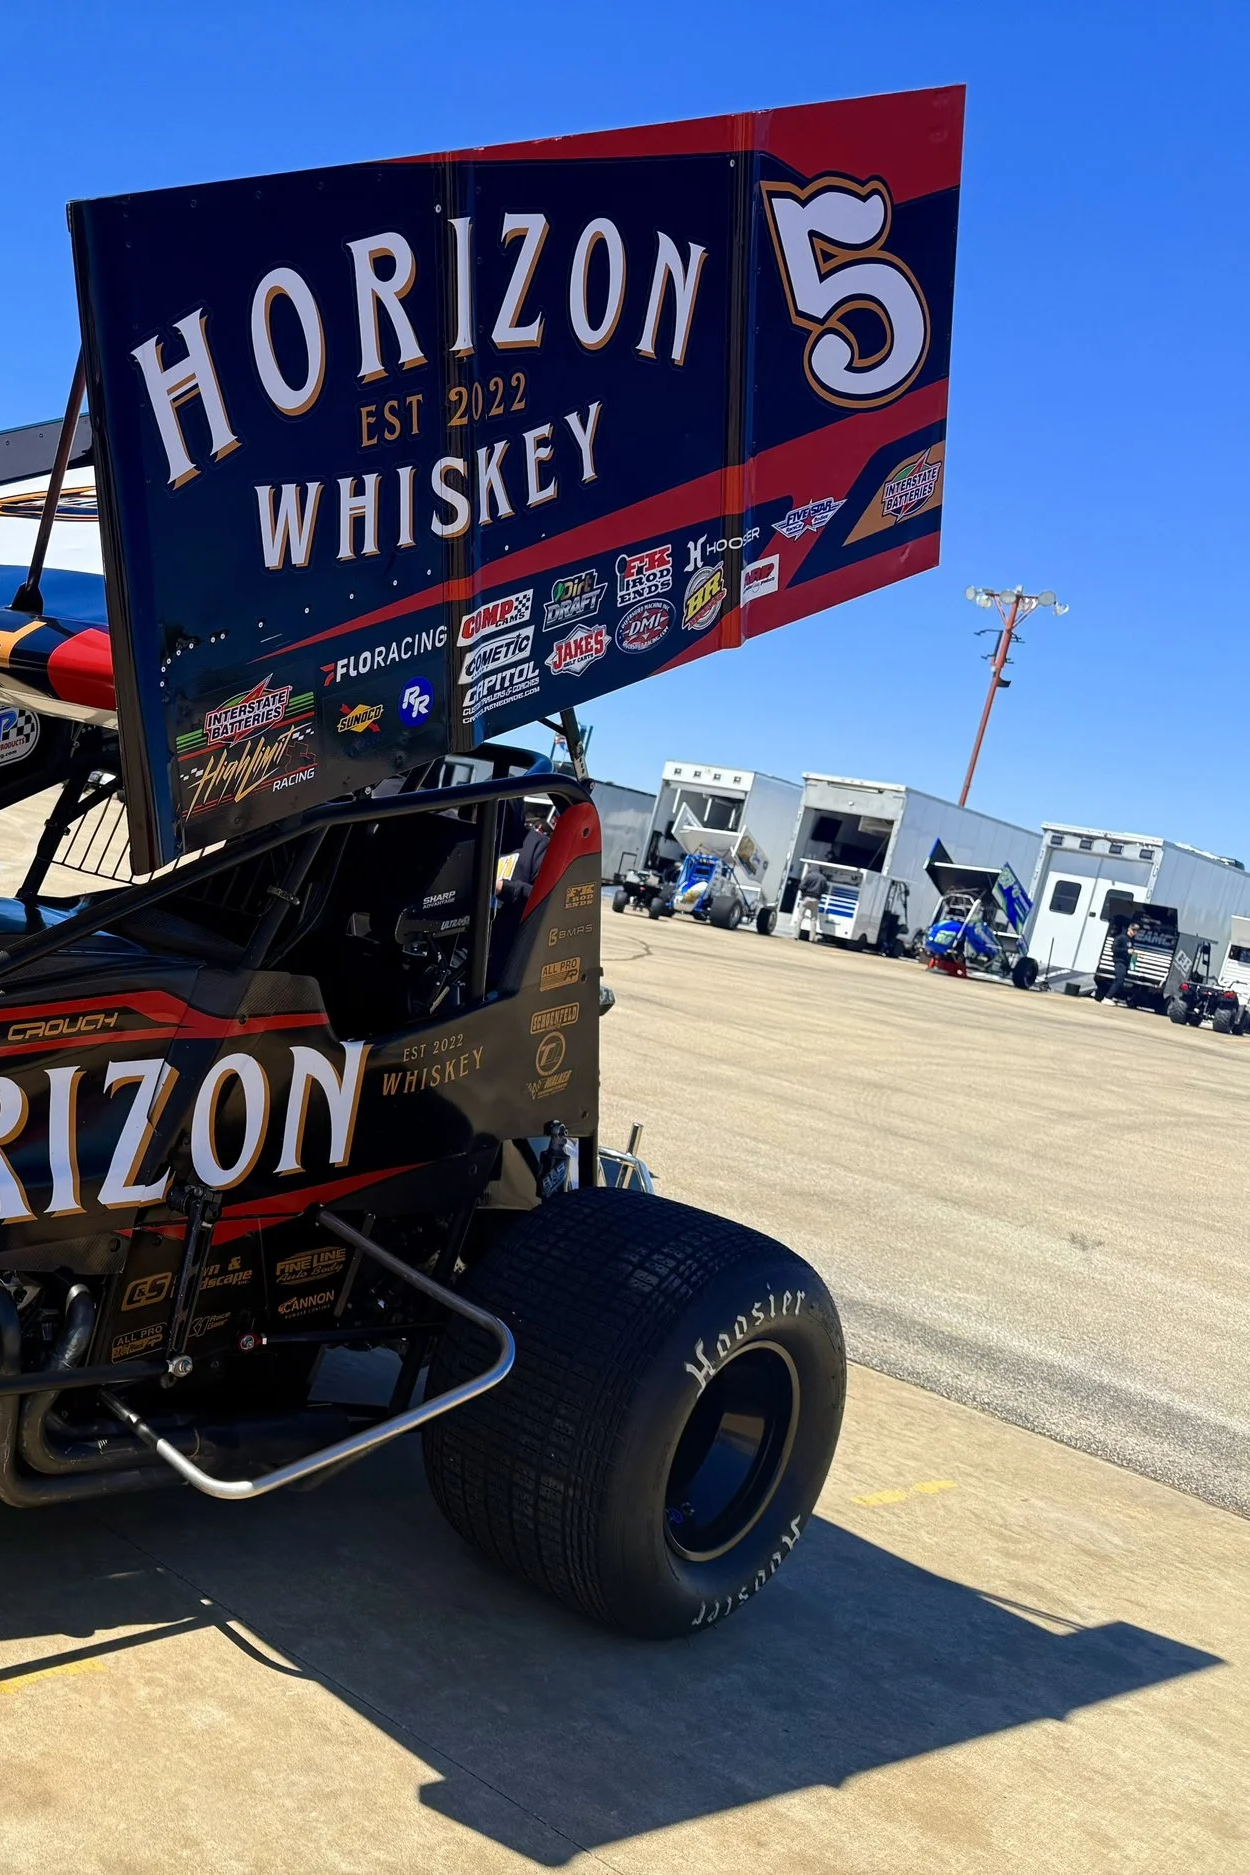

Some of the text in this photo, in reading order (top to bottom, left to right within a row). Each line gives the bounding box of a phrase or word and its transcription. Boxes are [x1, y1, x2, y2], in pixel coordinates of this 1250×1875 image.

[760, 175, 931, 409] 5
[130, 211, 708, 491] HORIZON
[359, 371, 528, 448] EST 2022
[255, 401, 604, 570] WHISKEY
[885, 466, 939, 497] INTERSTATE
[885, 481, 935, 511] BATTERIES
[786, 499, 833, 527] FIVE STAR
[625, 546, 671, 578] FK
[618, 579, 671, 604] ENDS
[630, 567, 670, 589] ROD
[462, 599, 514, 641] COMP
[495, 611, 525, 628] CAMS
[546, 589, 601, 624] DRAFT
[628, 612, 661, 637] DMI
[465, 633, 530, 678] COMETIC
[552, 629, 605, 670] JAKES
[462, 661, 540, 708] CAPITOL
[207, 691, 288, 728] INTERSTATE
[401, 684, 431, 718] RR
[210, 705, 283, 740] BATTERIES
[338, 704, 384, 733] SUNOCO
[272, 767, 316, 792] RACING
[423, 890, 456, 905] SHARP
[558, 924, 593, 939] BMRS
[542, 962, 557, 977] ALL
[560, 958, 578, 973] PRO
[7, 1012, 120, 1042] CROUCH
[403, 1033, 464, 1062] EST 2022
[382, 1046, 484, 1097] WHISKEY
[276, 1248, 347, 1276] FINE LINE
[282, 1290, 335, 1313] CANNON
[116, 1333, 136, 1347] ALL
[139, 1325, 163, 1339] PRO
[684, 1283, 807, 1399] Hoosier
